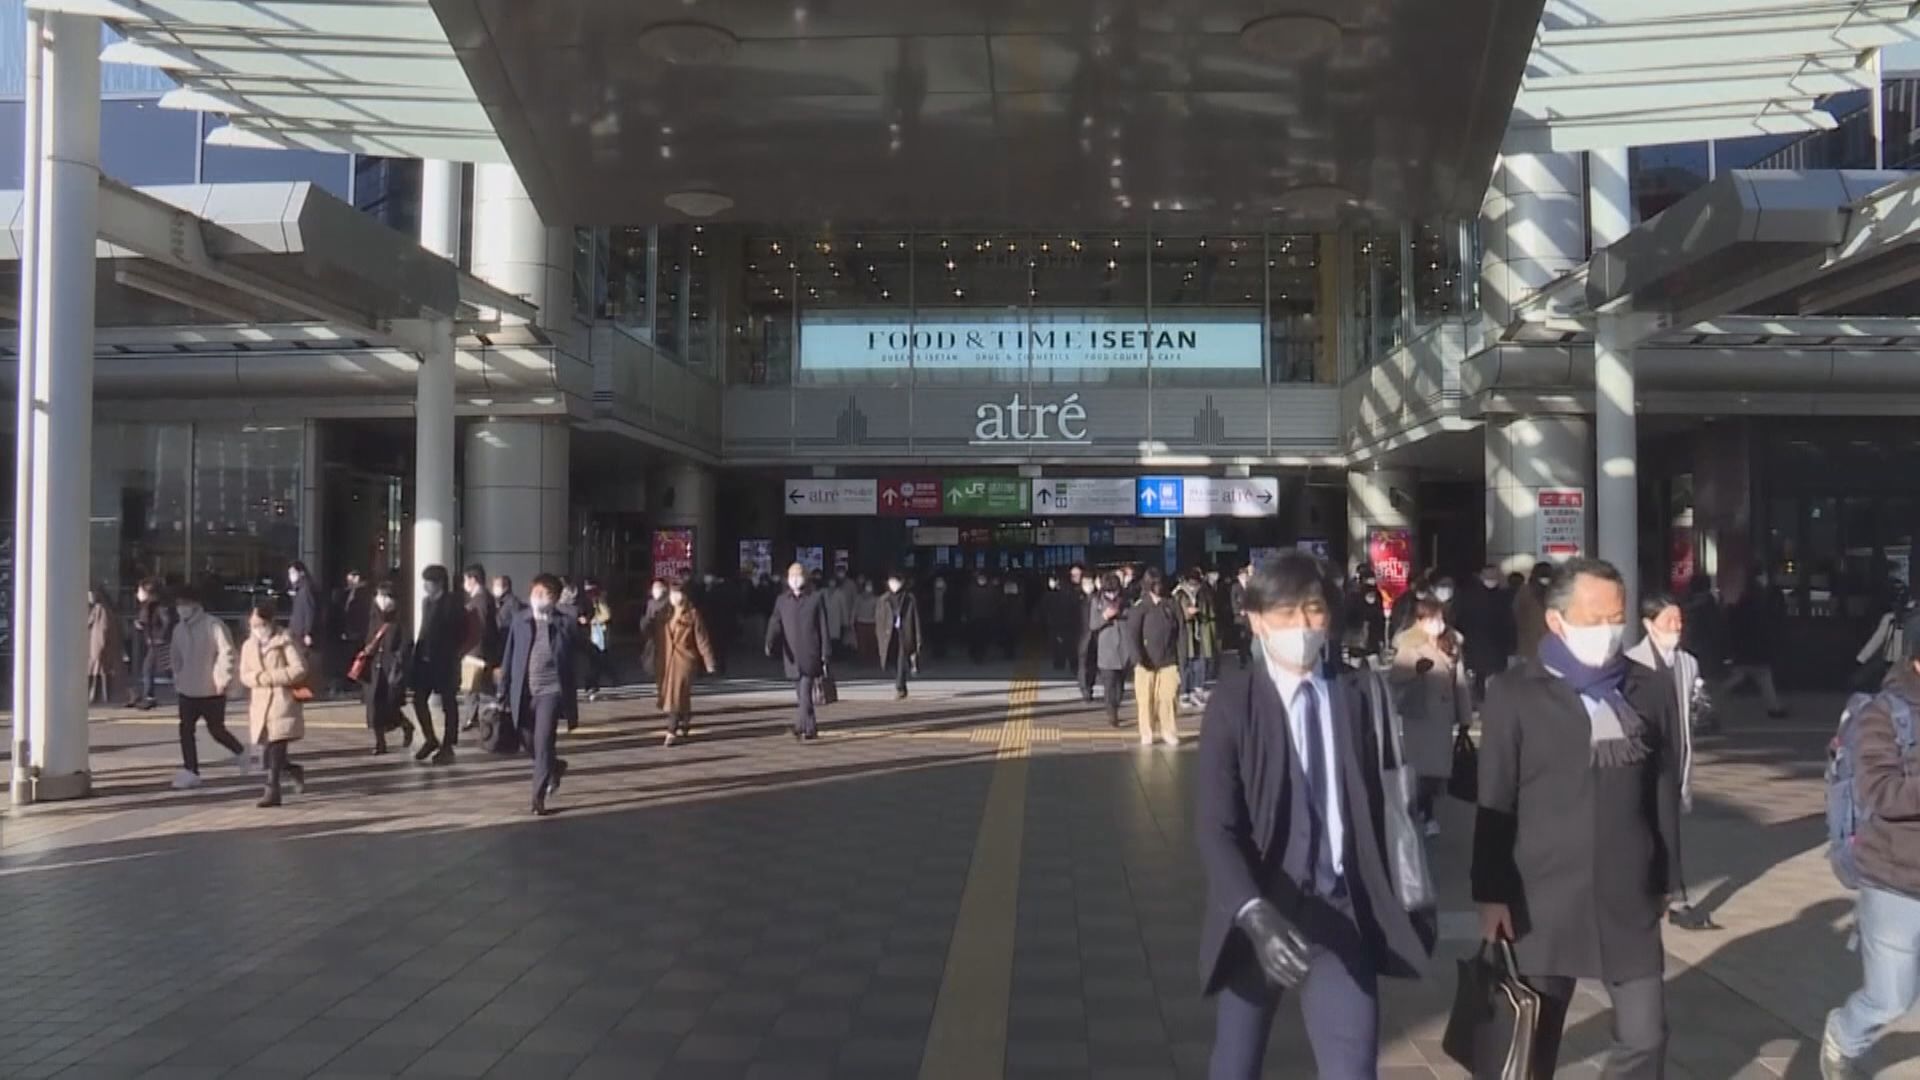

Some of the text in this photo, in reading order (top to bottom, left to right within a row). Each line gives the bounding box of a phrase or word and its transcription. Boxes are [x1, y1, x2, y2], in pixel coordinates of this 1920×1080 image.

[868, 330, 1196, 350] FOOD & TIME ISETAN
[975, 393, 1087, 439] atré
[965, 483, 985, 495] JR
